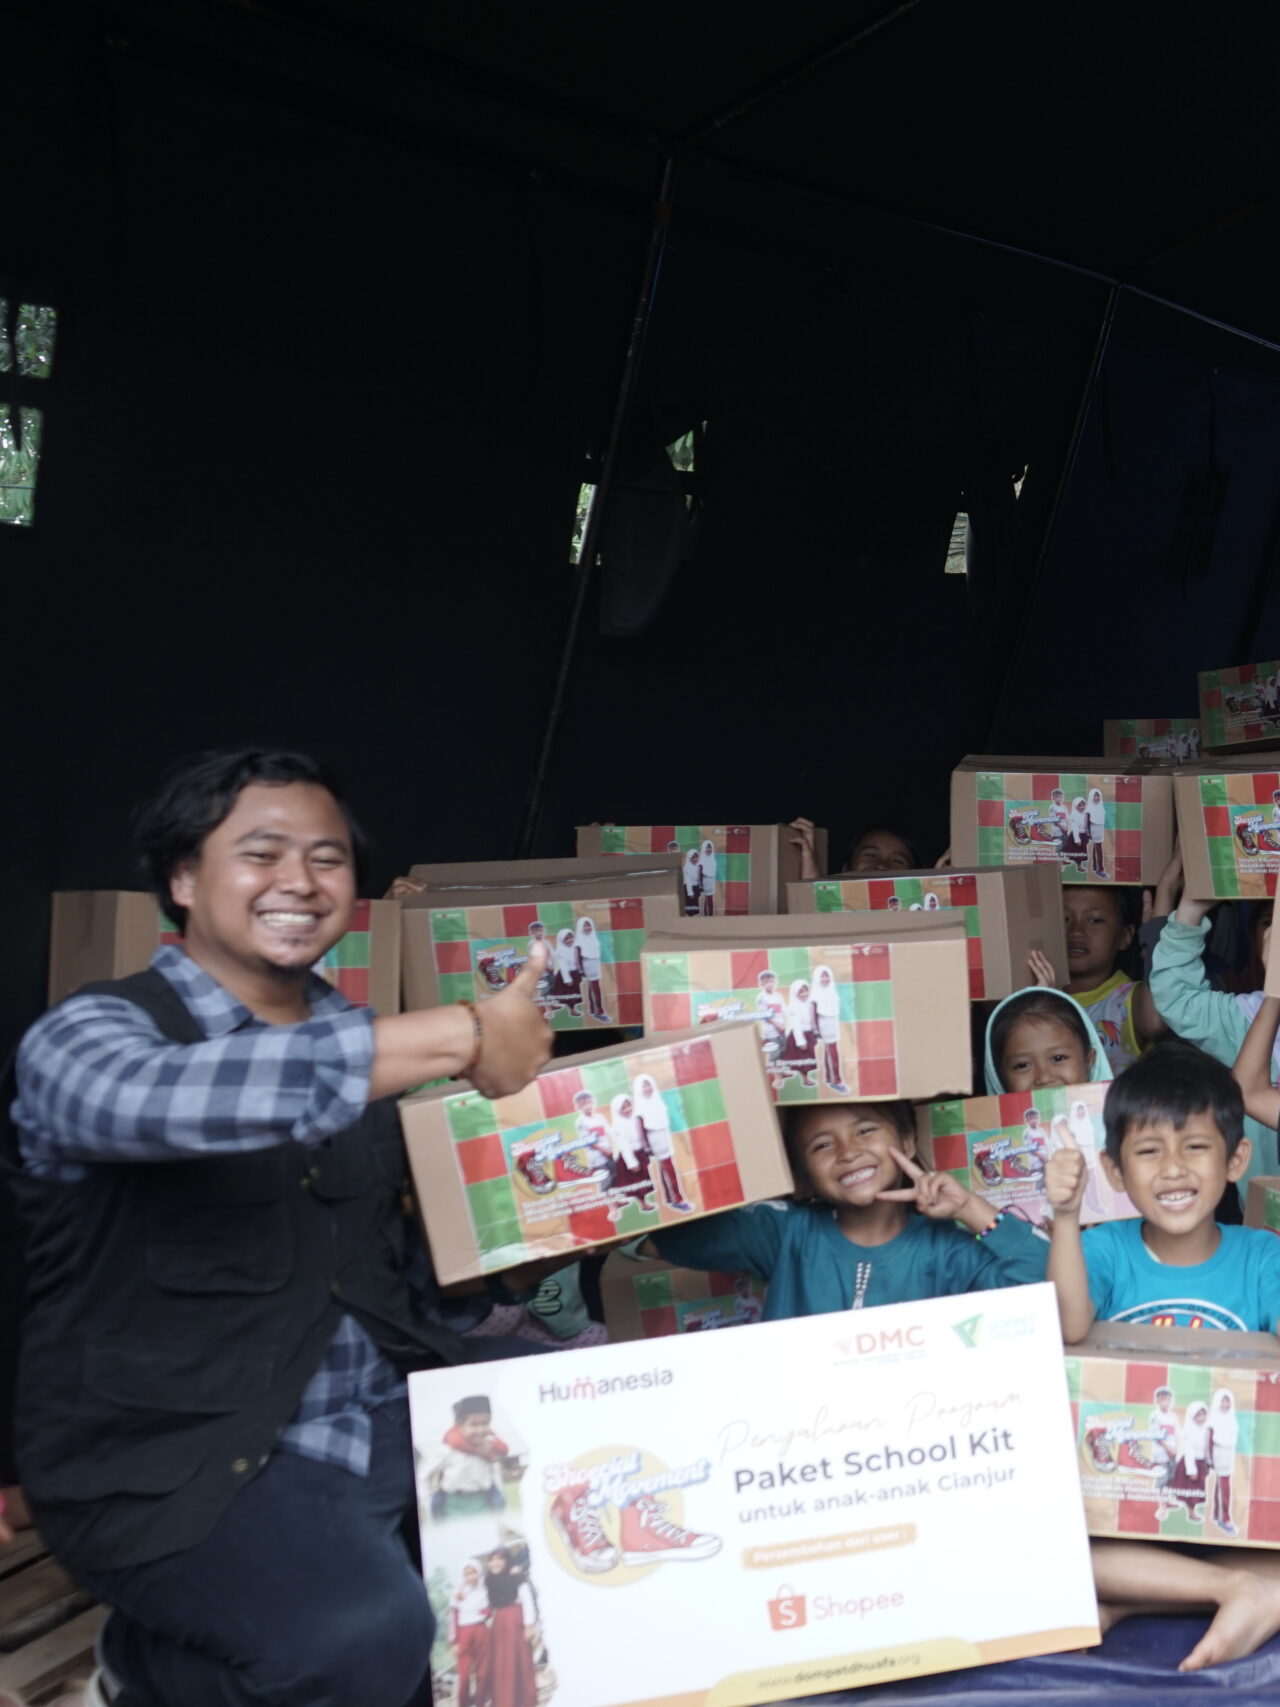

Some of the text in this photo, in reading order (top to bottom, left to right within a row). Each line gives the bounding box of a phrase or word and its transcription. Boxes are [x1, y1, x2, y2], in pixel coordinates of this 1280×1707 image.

[856, 1325, 925, 1355] DMC
[539, 1367, 674, 1404] Humanesia
[734, 1427, 1015, 1493] Paket School Kit
[588, 1457, 712, 1509] Movement
[738, 1465, 1017, 1524] untuk anak-anak Cianjur
[812, 1591, 905, 1620] Shopee
